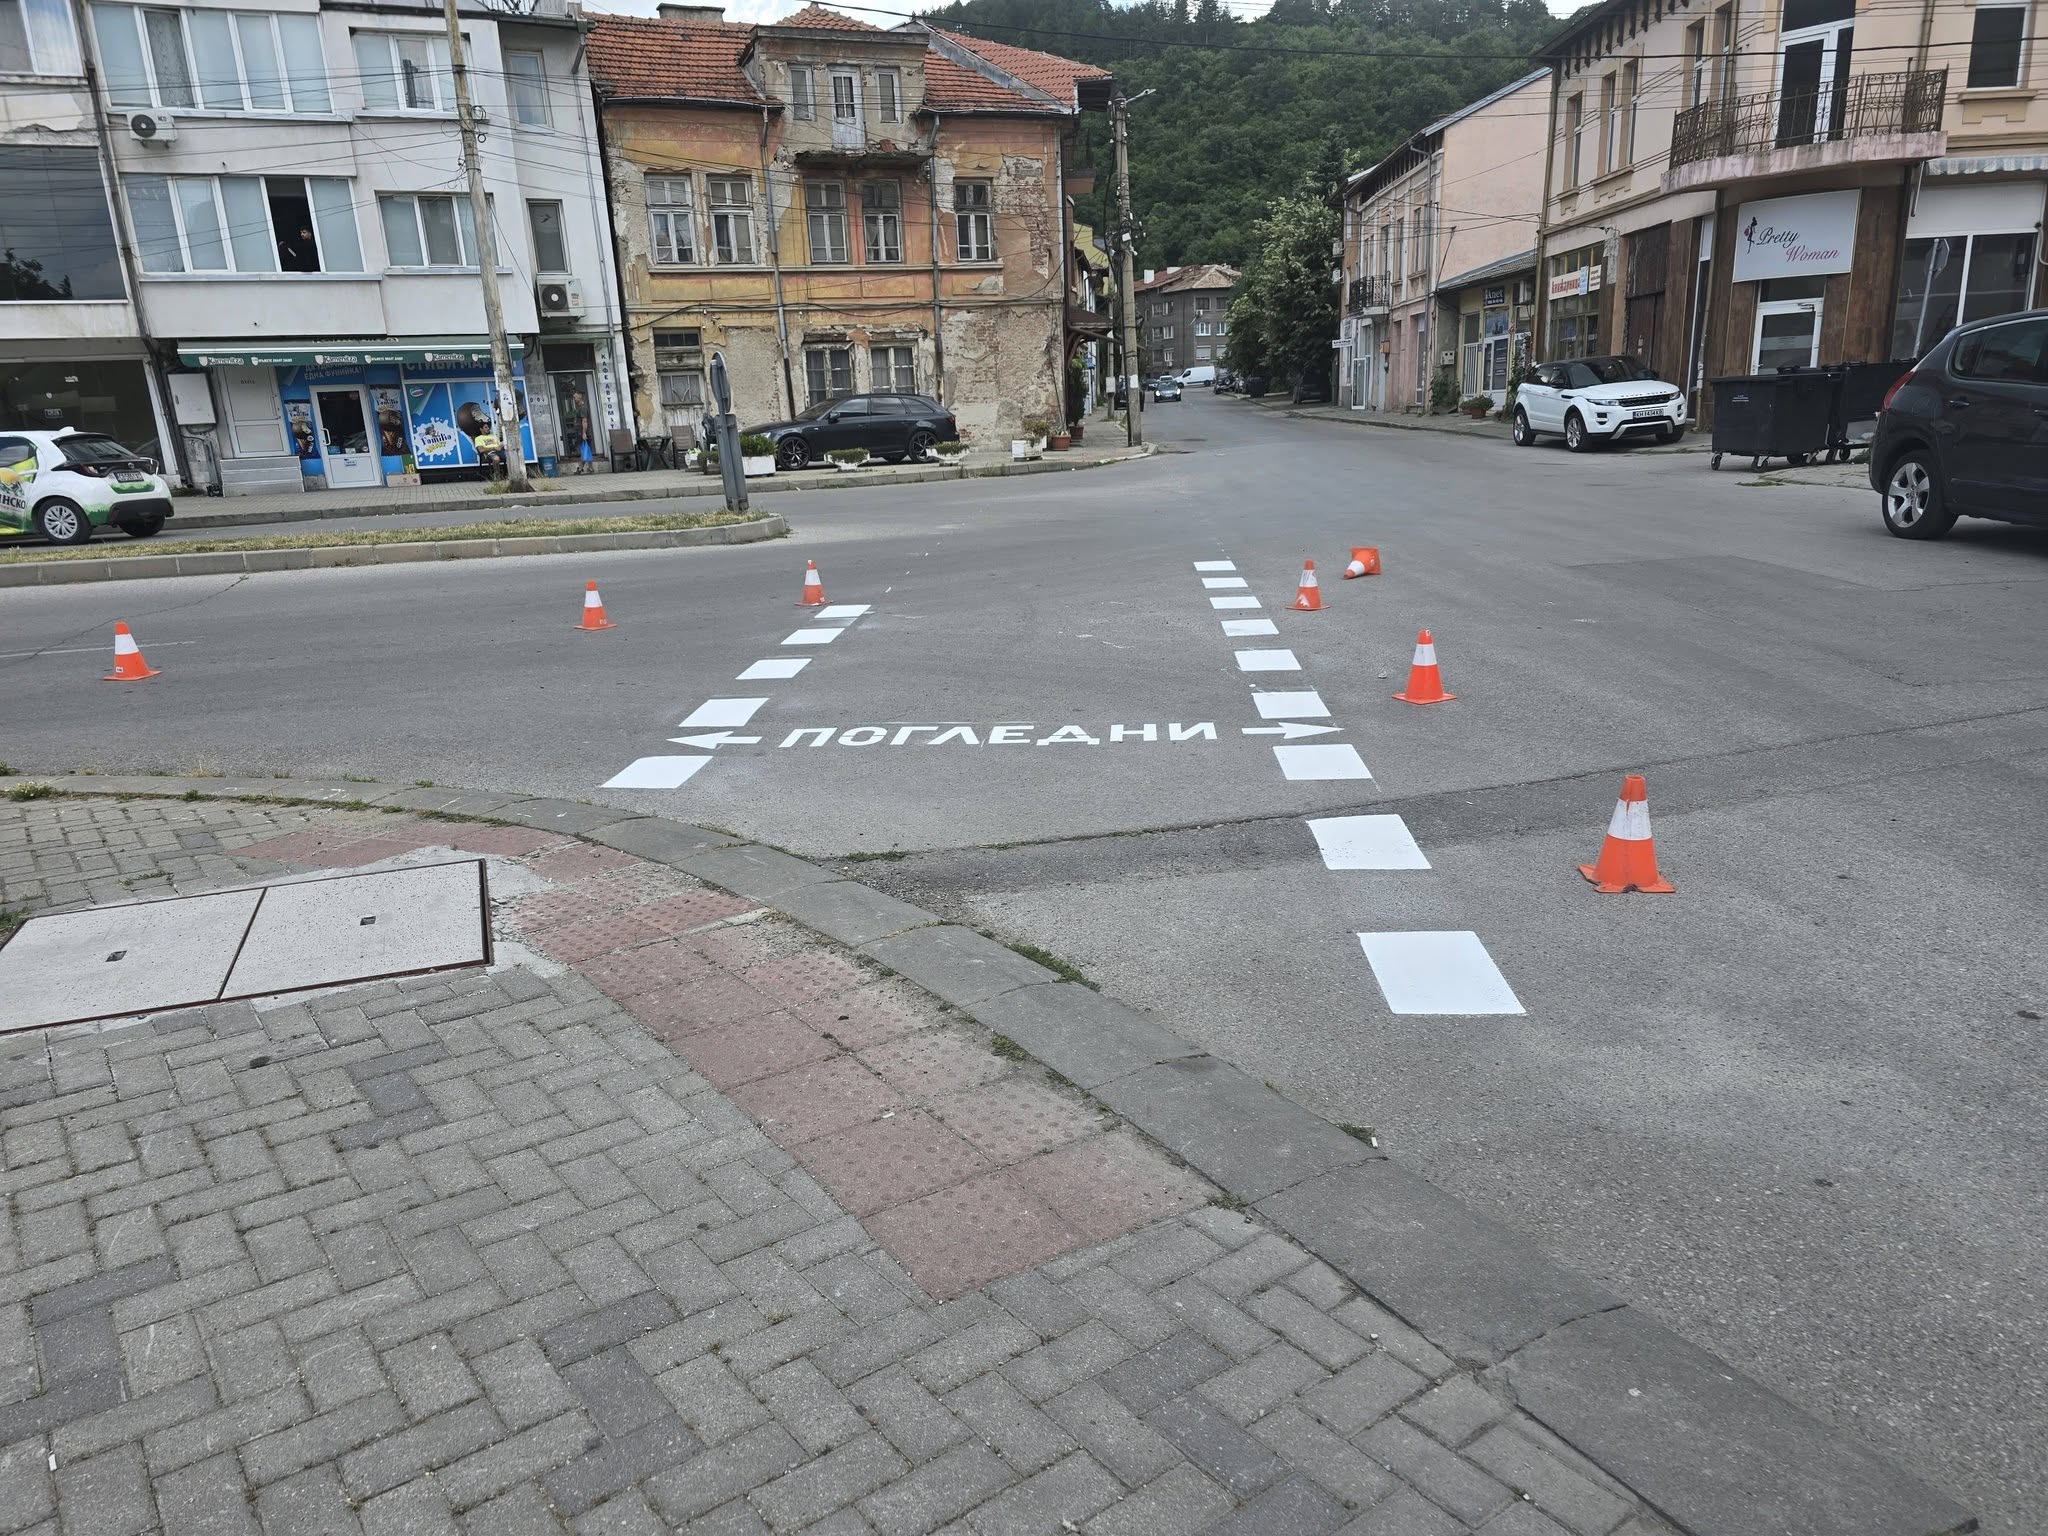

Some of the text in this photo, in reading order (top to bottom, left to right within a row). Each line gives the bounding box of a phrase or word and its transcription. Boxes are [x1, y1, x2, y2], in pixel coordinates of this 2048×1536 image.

[1756, 226, 1800, 248] Pretty
[1785, 245, 1839, 262] Woman
[324, 354, 358, 364] Kamenitza
[432, 352, 465, 361] Kamenitza
[600, 353, 609, 380] КАФЕ
[421, 433, 452, 446] Familia
[778, 721, 1219, 748] ПОГЛЕДНИ
